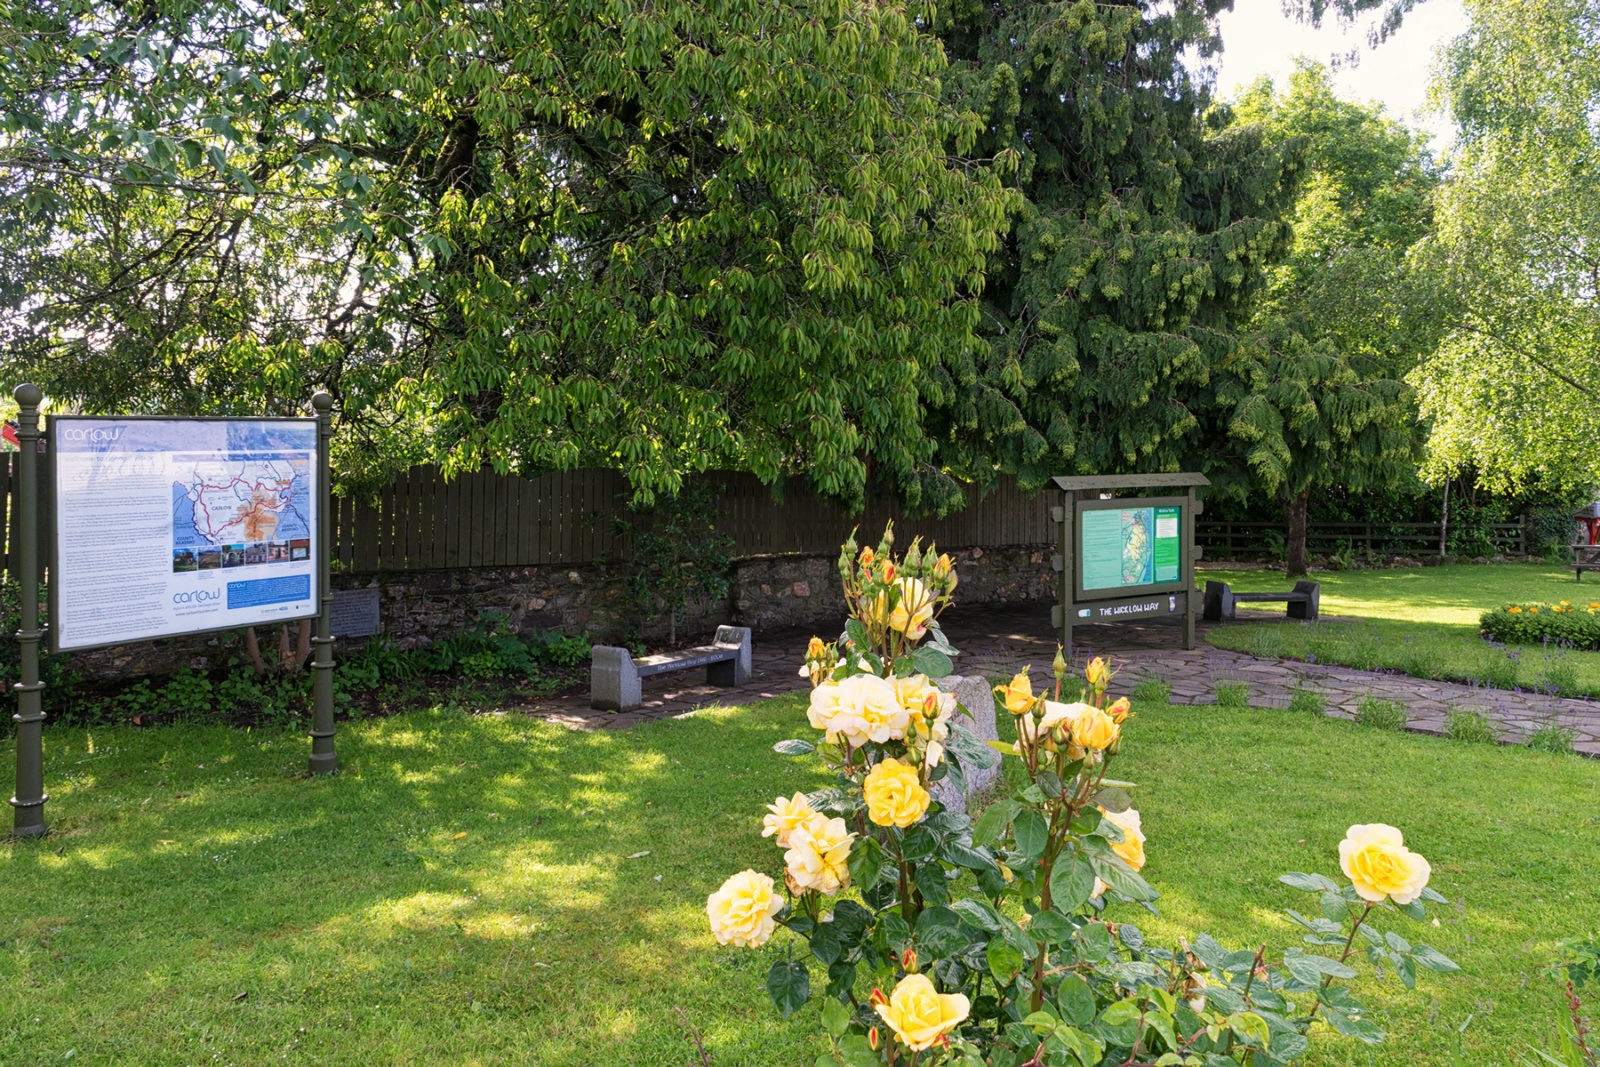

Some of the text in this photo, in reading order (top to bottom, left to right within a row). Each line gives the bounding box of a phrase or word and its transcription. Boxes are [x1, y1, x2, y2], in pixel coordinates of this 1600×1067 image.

[64, 428, 119, 443] carlow
[173, 588, 220, 604] carlow
[1099, 607, 1112, 616] THE
[1143, 602, 1159, 611] WAY
